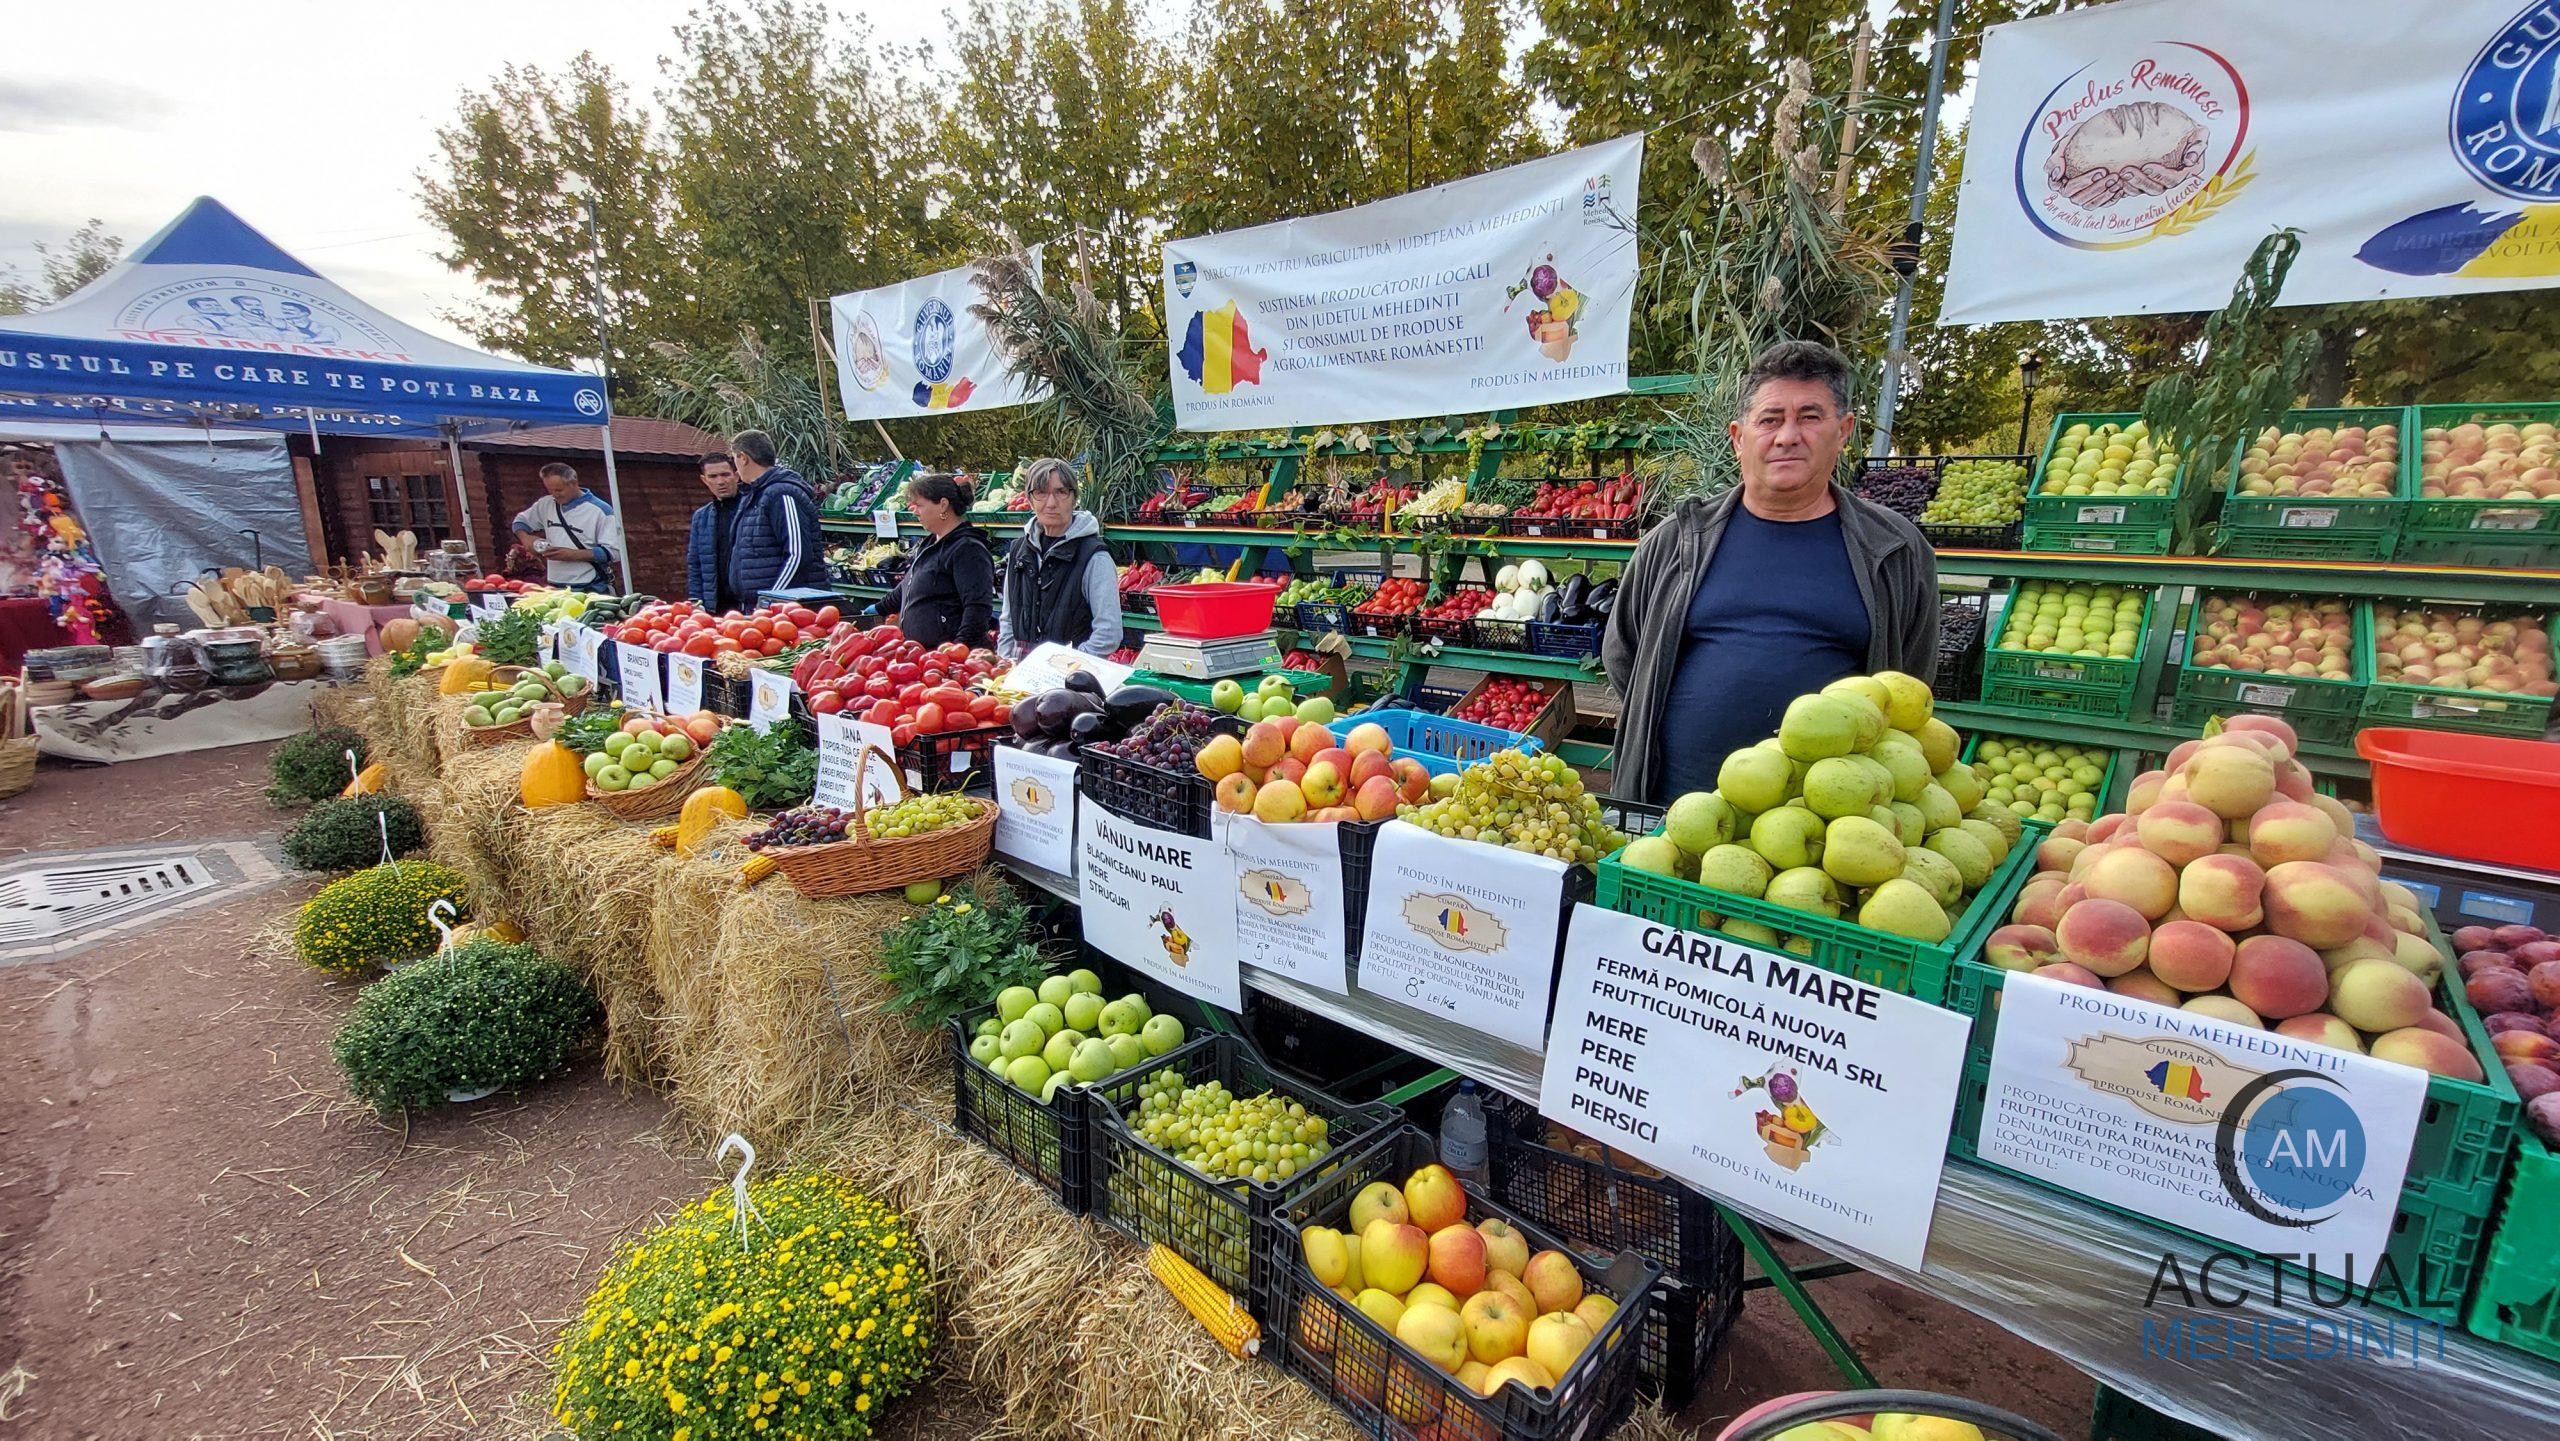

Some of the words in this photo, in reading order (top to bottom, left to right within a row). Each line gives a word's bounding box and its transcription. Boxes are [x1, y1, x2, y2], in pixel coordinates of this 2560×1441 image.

[2042, 80, 2124, 140] Produs
[2130, 59, 2224, 121] Românesc
[2056, 207, 2082, 228] pentru
[2107, 213, 2132, 230] Bine
[2134, 203, 2165, 228] pentru
[1203, 266, 1250, 282] DIRECȚIA
[1254, 258, 1301, 275] PENTRU
[1304, 240, 1392, 269] AGRICULTURĂ
[1398, 220, 1474, 256] JUDEȚEANĂ
[1479, 197, 1565, 234] MEHEDINȚI
[1259, 294, 1316, 315] SUSȚINEM
[1320, 273, 1431, 305] PRODUCĂTORII
[1435, 262, 1490, 287] LOCALI
[1286, 315, 1309, 331] DIN
[1311, 307, 1365, 331] JUDEȚUL
[1372, 292, 1459, 318] MEHEDINȚI
[1298, 330, 1365, 350] CONSUMUL
[1371, 326, 1389, 341] DE
[1394, 315, 1464, 338] PRODUSE
[1272, 349, 1387, 372] AGROALIMENTARE
[1391, 336, 1484, 360] ROMÂNEȘTI!
[150, 361, 195, 378] PE
[215, 365, 310, 386] CARE
[326, 373, 365, 390] TE
[381, 377, 456, 399] POȚI
[470, 384, 541, 403] BAZA
[1470, 373, 1519, 389] PRODUS
[1522, 369, 1538, 385] ÎN
[1541, 362, 1626, 382] MEHEDINȚI!
[1186, 399, 1218, 412] PRODUS
[1219, 396, 1229, 410] ÎN
[1231, 395, 1275, 409] ROMÂNIA!
[1096, 818, 1134, 854] VÂNJU
[1138, 840, 1193, 869] MARE
[1087, 842, 1147, 883] BLAGNICEANU
[1151, 874, 1184, 894] PAUL
[1088, 861, 1110, 884] MERE
[1397, 865, 1438, 886] PRODUS
[1440, 876, 1453, 890] ÎN
[1456, 884, 1526, 911] MEHEDINȚI!
[1089, 878, 1131, 911] STRUGURI
[1298, 934, 1315, 946] MERE
[1416, 924, 1446, 939] PRODUSE
[1143, 957, 1168, 975] PRODUS
[1312, 948, 1329, 961] MARE
[1370, 941, 1416, 964] DENUMIREA
[1474, 975, 1526, 1000] STRUGURI
[1433, 951, 1496, 979] BLAGNICEANU
[1497, 971, 1520, 987] PAUL
[1642, 925, 1755, 984] GÂRLA
[1765, 960, 1882, 1021] MARE
[1368, 952, 1413, 974] LOCALITATE
[1414, 966, 1426, 977] DE
[1464, 981, 1493, 1001] VÂNJU
[1493, 994, 1521, 1010] MARE
[1597, 957, 1660, 988] FERMĂ
[1664, 978, 1766, 1025] POMICOLĂ
[1772, 1012, 1849, 1050] NUOVA
[1585, 1010, 1649, 1047] MERE
[1591, 980, 1742, 1043] FRUTTICULTURA
[1746, 1029, 1840, 1076] RUMENA
[1844, 1062, 1889, 1093] SRL
[2059, 992, 2148, 1026] PRODUS
[2155, 1012, 2183, 1033] ÎN
[2188, 1022, 2347, 1074] MEHEDINȚI!
[1581, 1038, 1637, 1073] PERE
[2145, 1043, 2215, 1068] CUMPĂRĂ
[1575, 1066, 1651, 1109] PRUNE
[2100, 1080, 2164, 1104] PRODUSE
[1570, 1092, 1659, 1144] PIERSICI
[2000, 1099, 2127, 1145] FRUTTICULTURA
[2132, 1137, 2206, 1170] RUMENA
[2211, 1159, 2242, 1178] SRL
[1993, 1141, 2058, 1171] PREȚUL:
[1998, 1113, 2092, 1151] DENUMIREA
[2098, 1142, 2212, 1187] PRODUSULUI:
[2003, 1084, 2127, 1128] PRODUCĂTOR:
[2133, 1121, 2190, 1148] FERMĂ
[2196, 1139, 2295, 1178] POMICOLĂ
[2299, 1169, 2376, 1202] NUOVA
[1691, 1144, 1750, 1178] PRODUS
[1754, 1166, 1772, 1186] ÎN
[1774, 1176, 1874, 1227] MEHEDINȚI!
[1995, 1127, 2085, 1164] LOCALITATE
[2090, 1156, 2113, 1173] DE
[2116, 1163, 2195, 1197] ORIGINE:
[2198, 1189, 2257, 1216] GÂRLA
[2261, 1211, 2317, 1235] MARE
